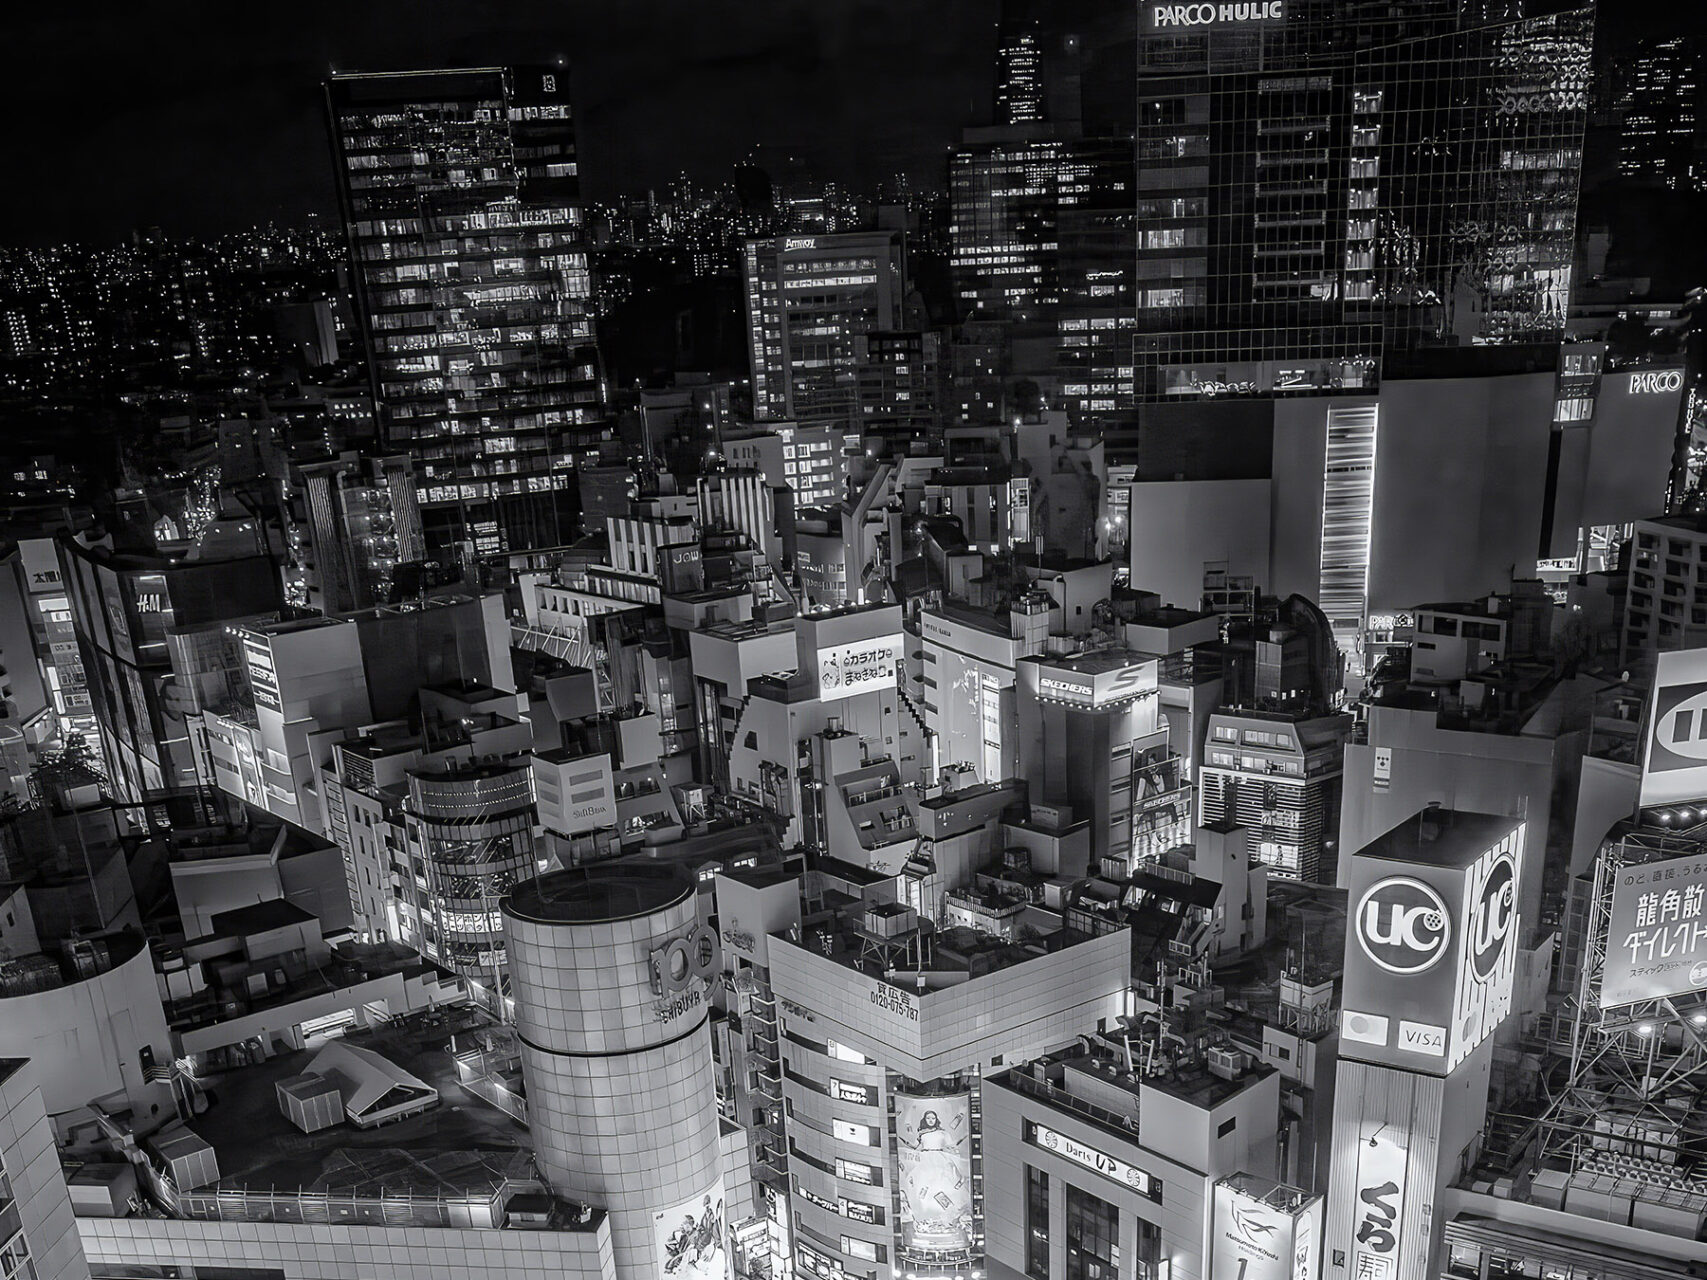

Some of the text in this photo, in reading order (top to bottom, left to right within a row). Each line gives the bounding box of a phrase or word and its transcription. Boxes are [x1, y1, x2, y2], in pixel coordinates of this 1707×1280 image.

[1154, 1, 1282, 27] PARCO HULIC
[1628, 371, 1683, 394] PARCO
[136, 594, 160, 613] H&M
[849, 649, 886, 666] カラオケ
[1039, 678, 1093, 695] SKECHERS
[1635, 883, 1706, 927] 龍角散
[1622, 921, 1702, 964] ダイレクト
[1405, 1029, 1442, 1047] VISA
[1066, 1142, 1117, 1175] Darts UP
